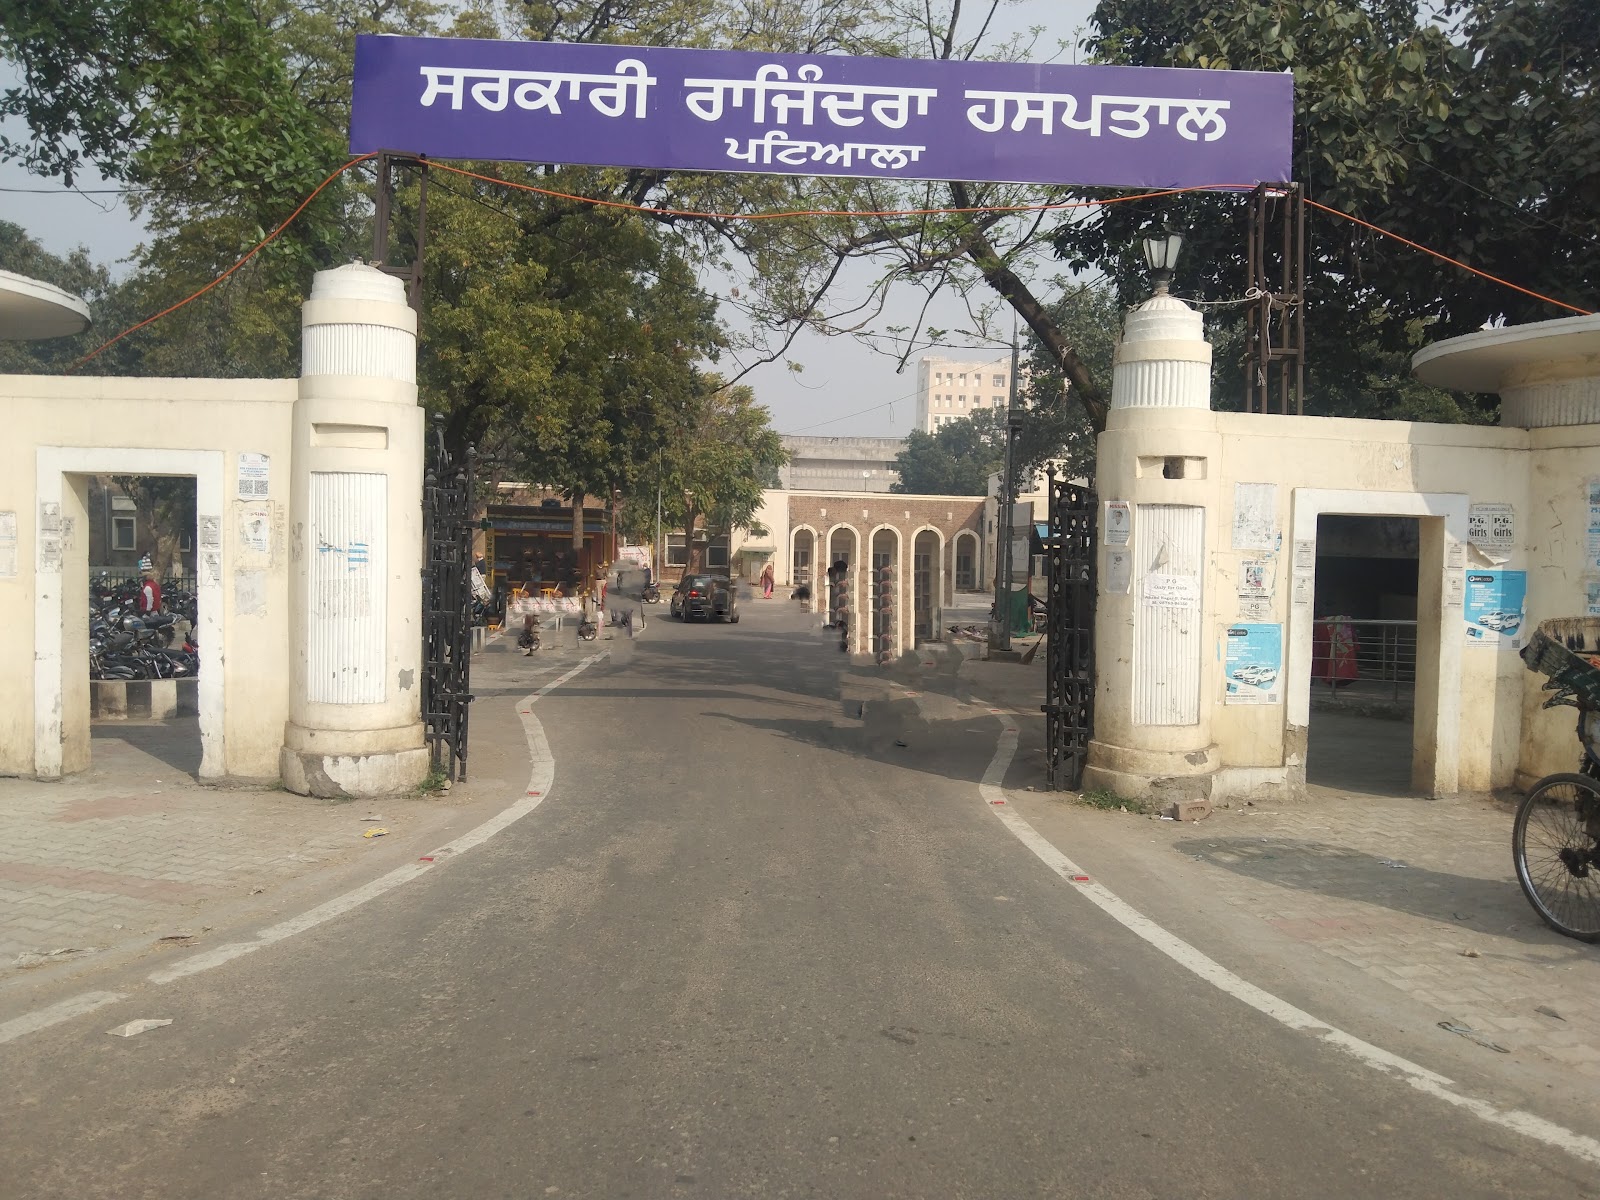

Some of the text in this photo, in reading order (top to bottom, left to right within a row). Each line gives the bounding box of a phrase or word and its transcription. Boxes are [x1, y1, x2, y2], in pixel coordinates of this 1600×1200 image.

[419, 58, 1231, 142] ਸਰਕਾਰੀ ਰਾਜਿੰਦਰਾ ਹਸਪਤਾਲ
[724, 130, 927, 170] ਪਟਿਆਲਾ
[1469, 528, 1487, 537] Girls
[1494, 528, 1512, 537] Girls
